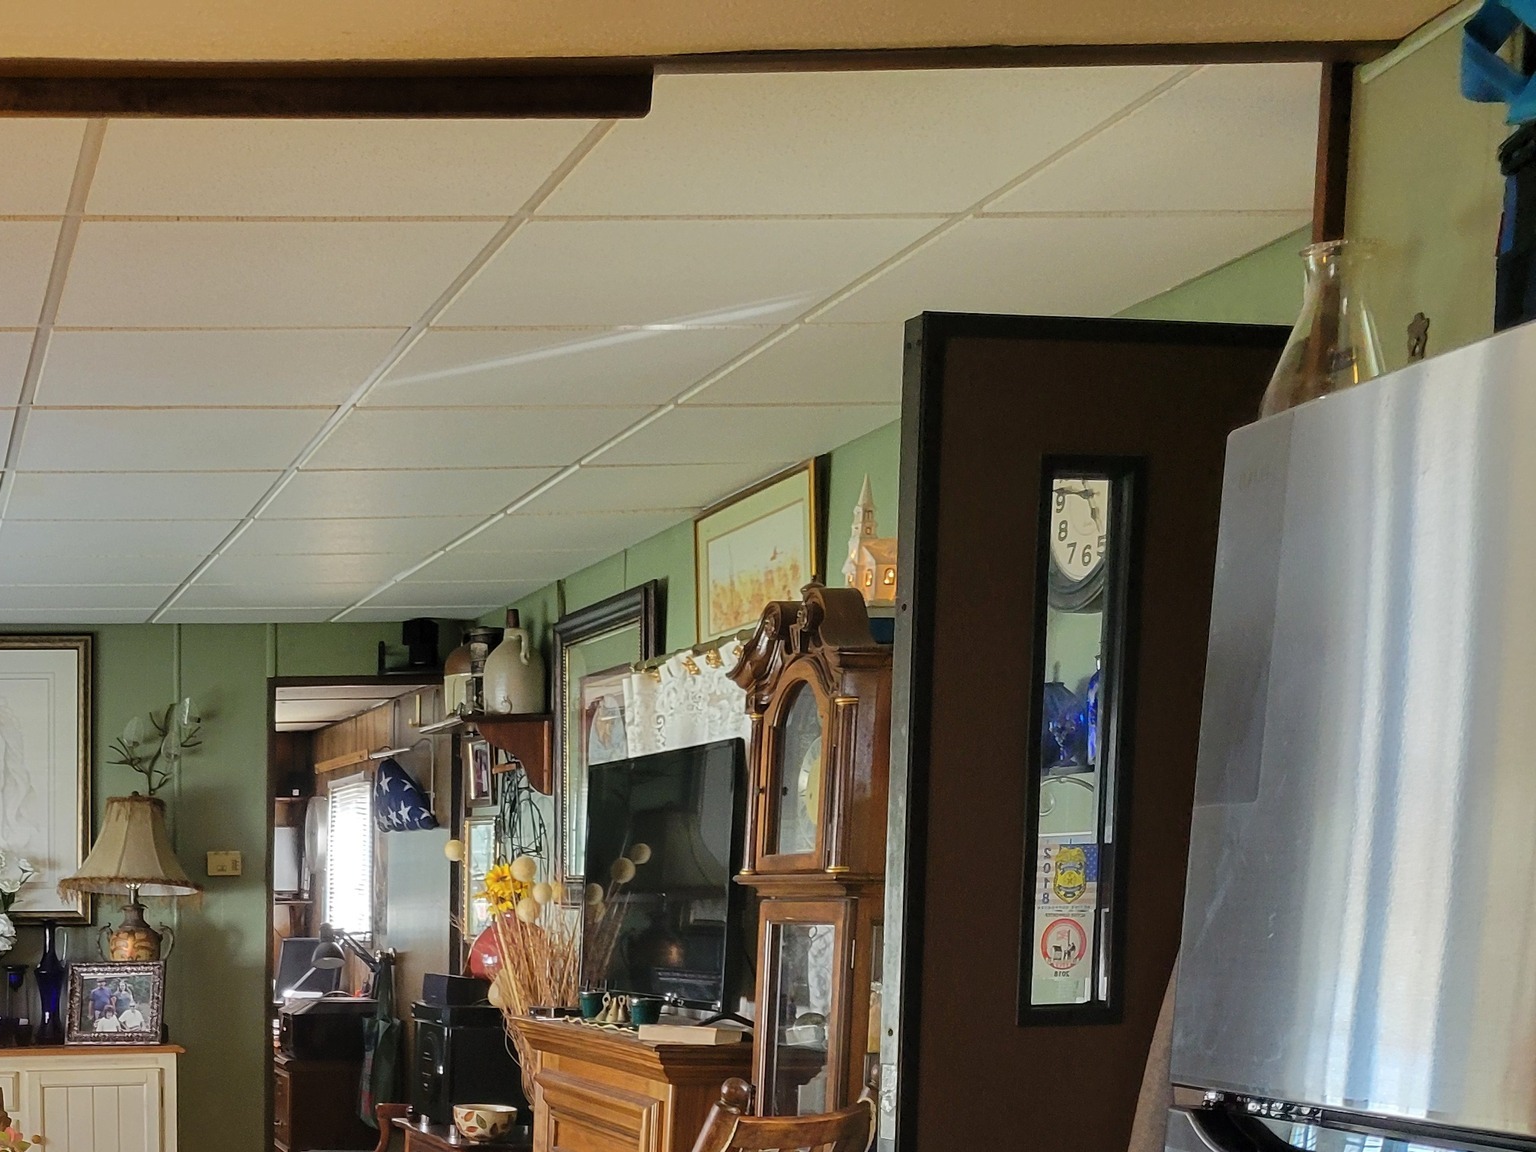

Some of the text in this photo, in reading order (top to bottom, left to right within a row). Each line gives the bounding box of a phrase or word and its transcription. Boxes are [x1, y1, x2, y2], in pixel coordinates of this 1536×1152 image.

[1058, 519, 1068, 542] 8
[1066, 542, 1077, 564] 7
[1081, 544, 1092, 566] 6
